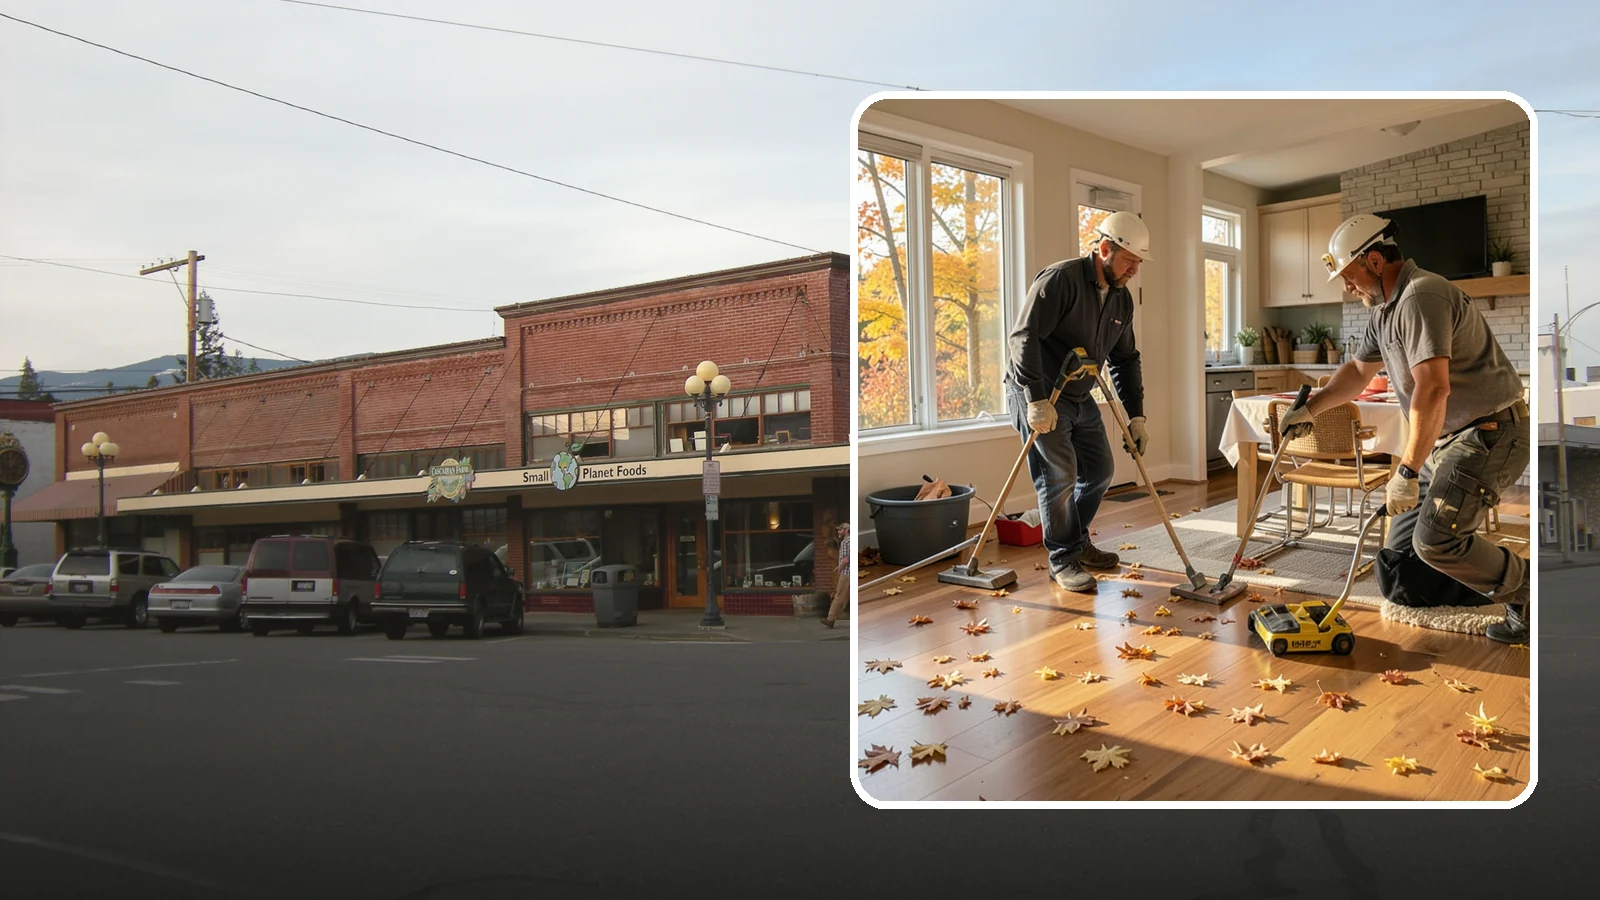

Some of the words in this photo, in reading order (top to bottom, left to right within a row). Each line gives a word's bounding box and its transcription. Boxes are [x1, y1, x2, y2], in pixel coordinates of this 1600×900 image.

[523, 471, 549, 483] Small
[583, 467, 614, 479] Planet
[617, 464, 647, 476] Foods
